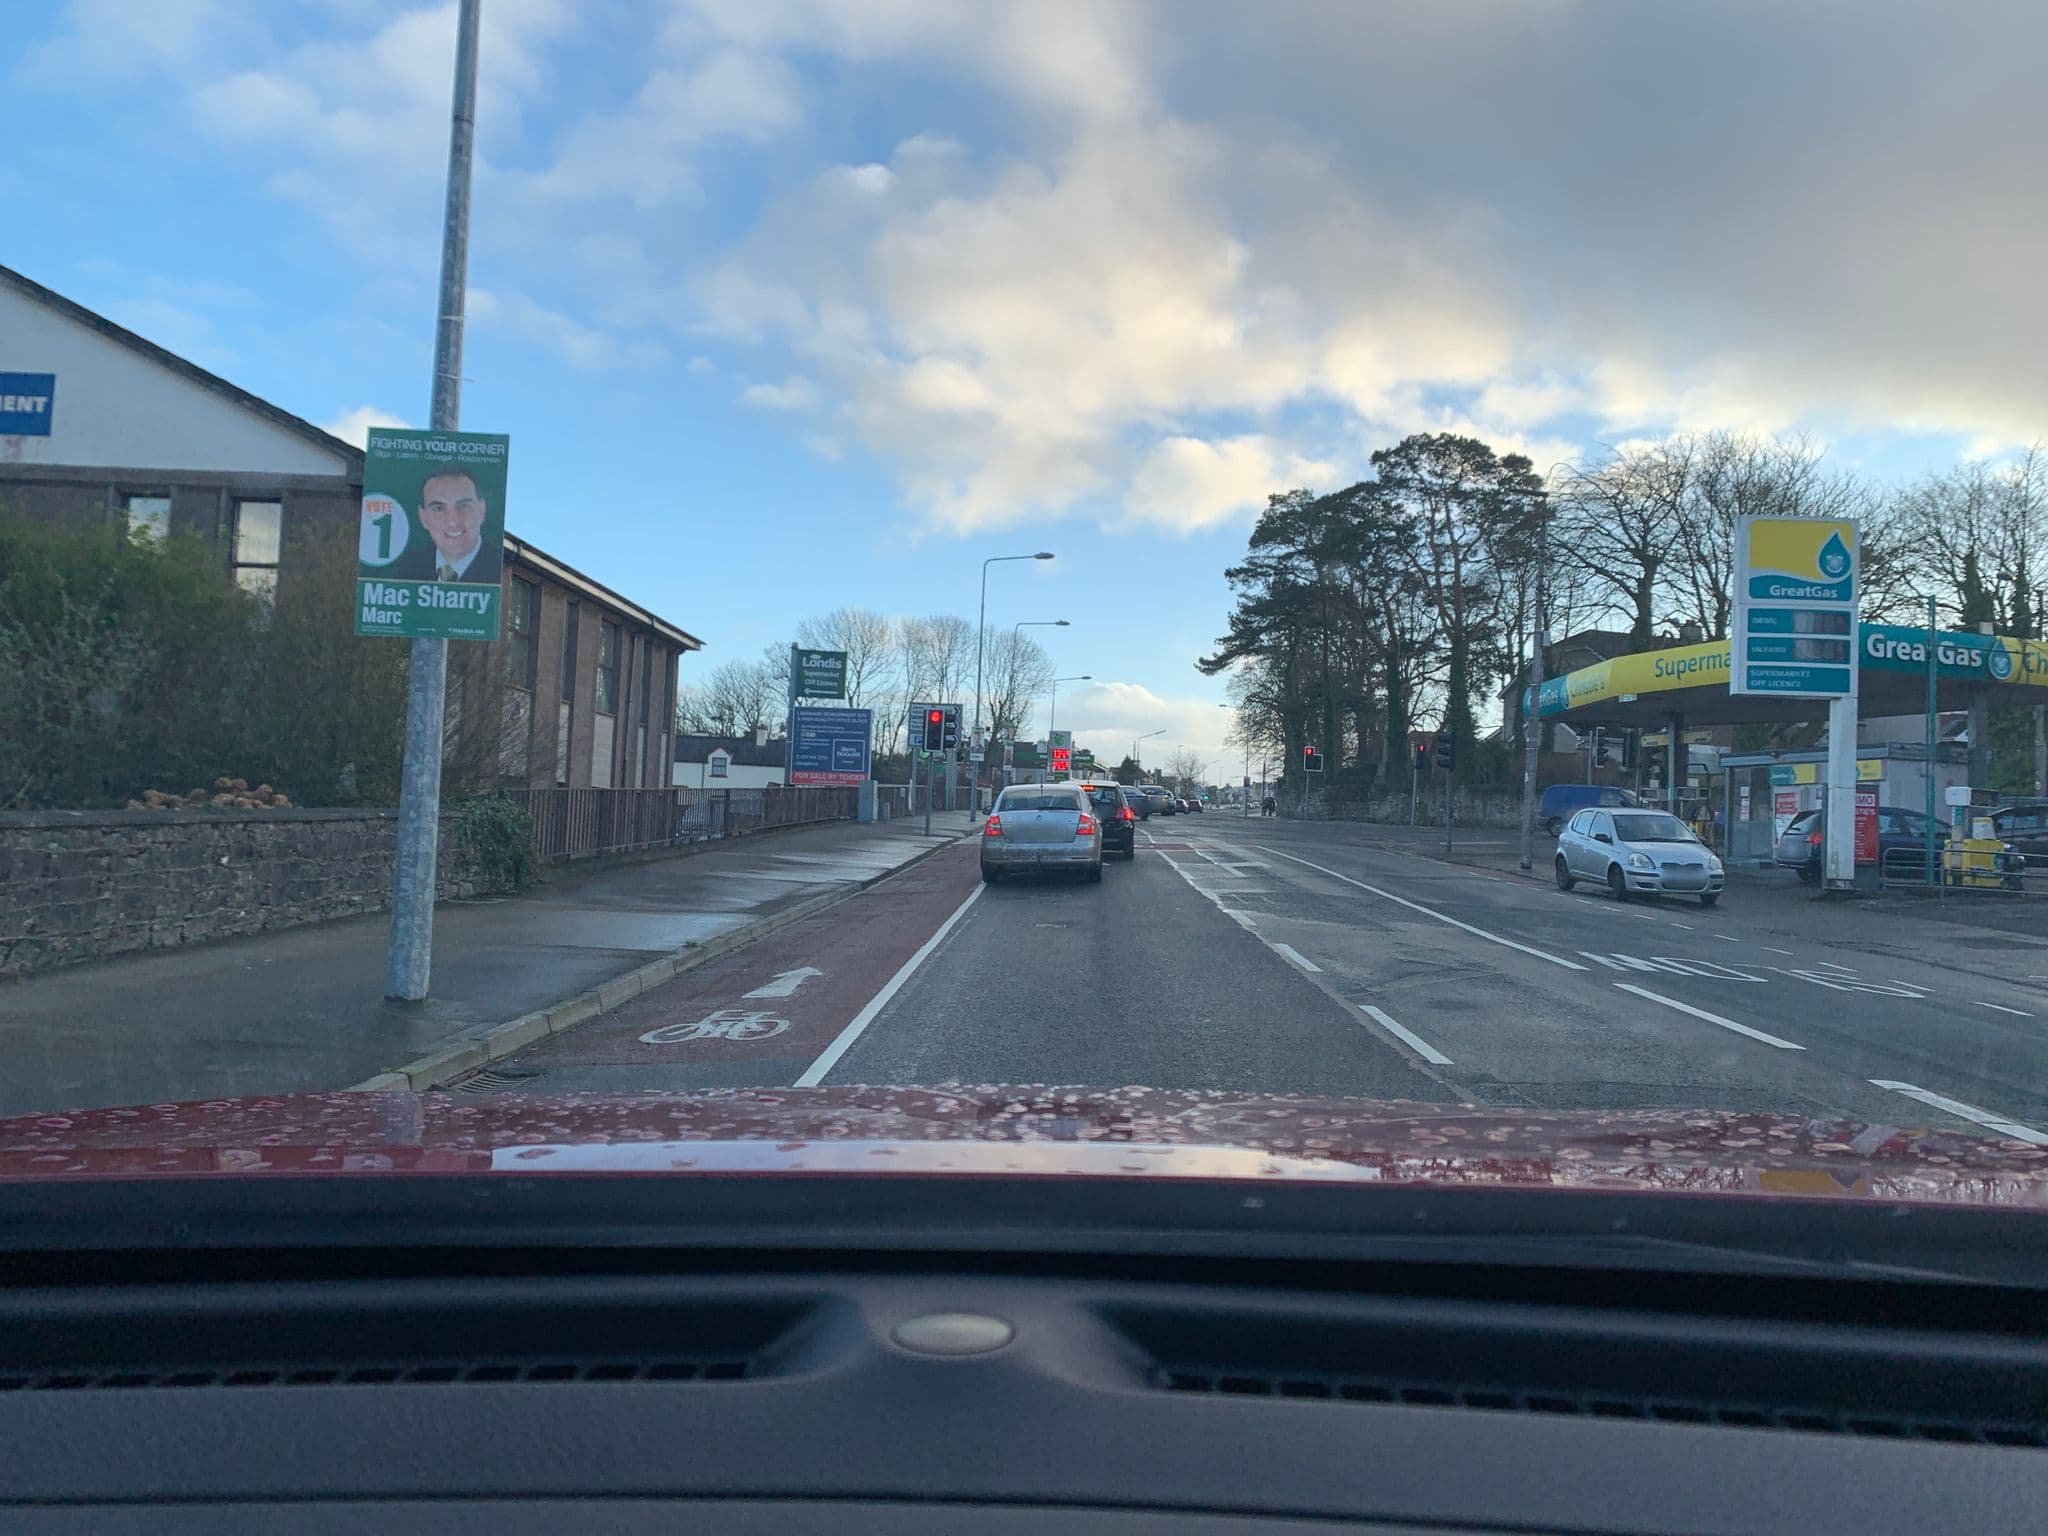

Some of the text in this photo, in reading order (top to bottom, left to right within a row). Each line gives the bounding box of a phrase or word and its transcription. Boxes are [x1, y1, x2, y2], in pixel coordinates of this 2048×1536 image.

[0, 395, 48, 412] ENT
[370, 437, 505, 455] FIGHTING YOUR CORNER
[372, 513, 392, 559] 1
[363, 582, 491, 615] Mac Sharry
[1769, 584, 1838, 599] GreatGas
[361, 606, 402, 624] Marc
[1866, 633, 1983, 668] GreaGas
[802, 656, 842, 670] Londis
[1654, 652, 1731, 680] Superma
[1750, 670, 1811, 678] SUPERMARKET
[1767, 680, 1801, 688] LICENCE
